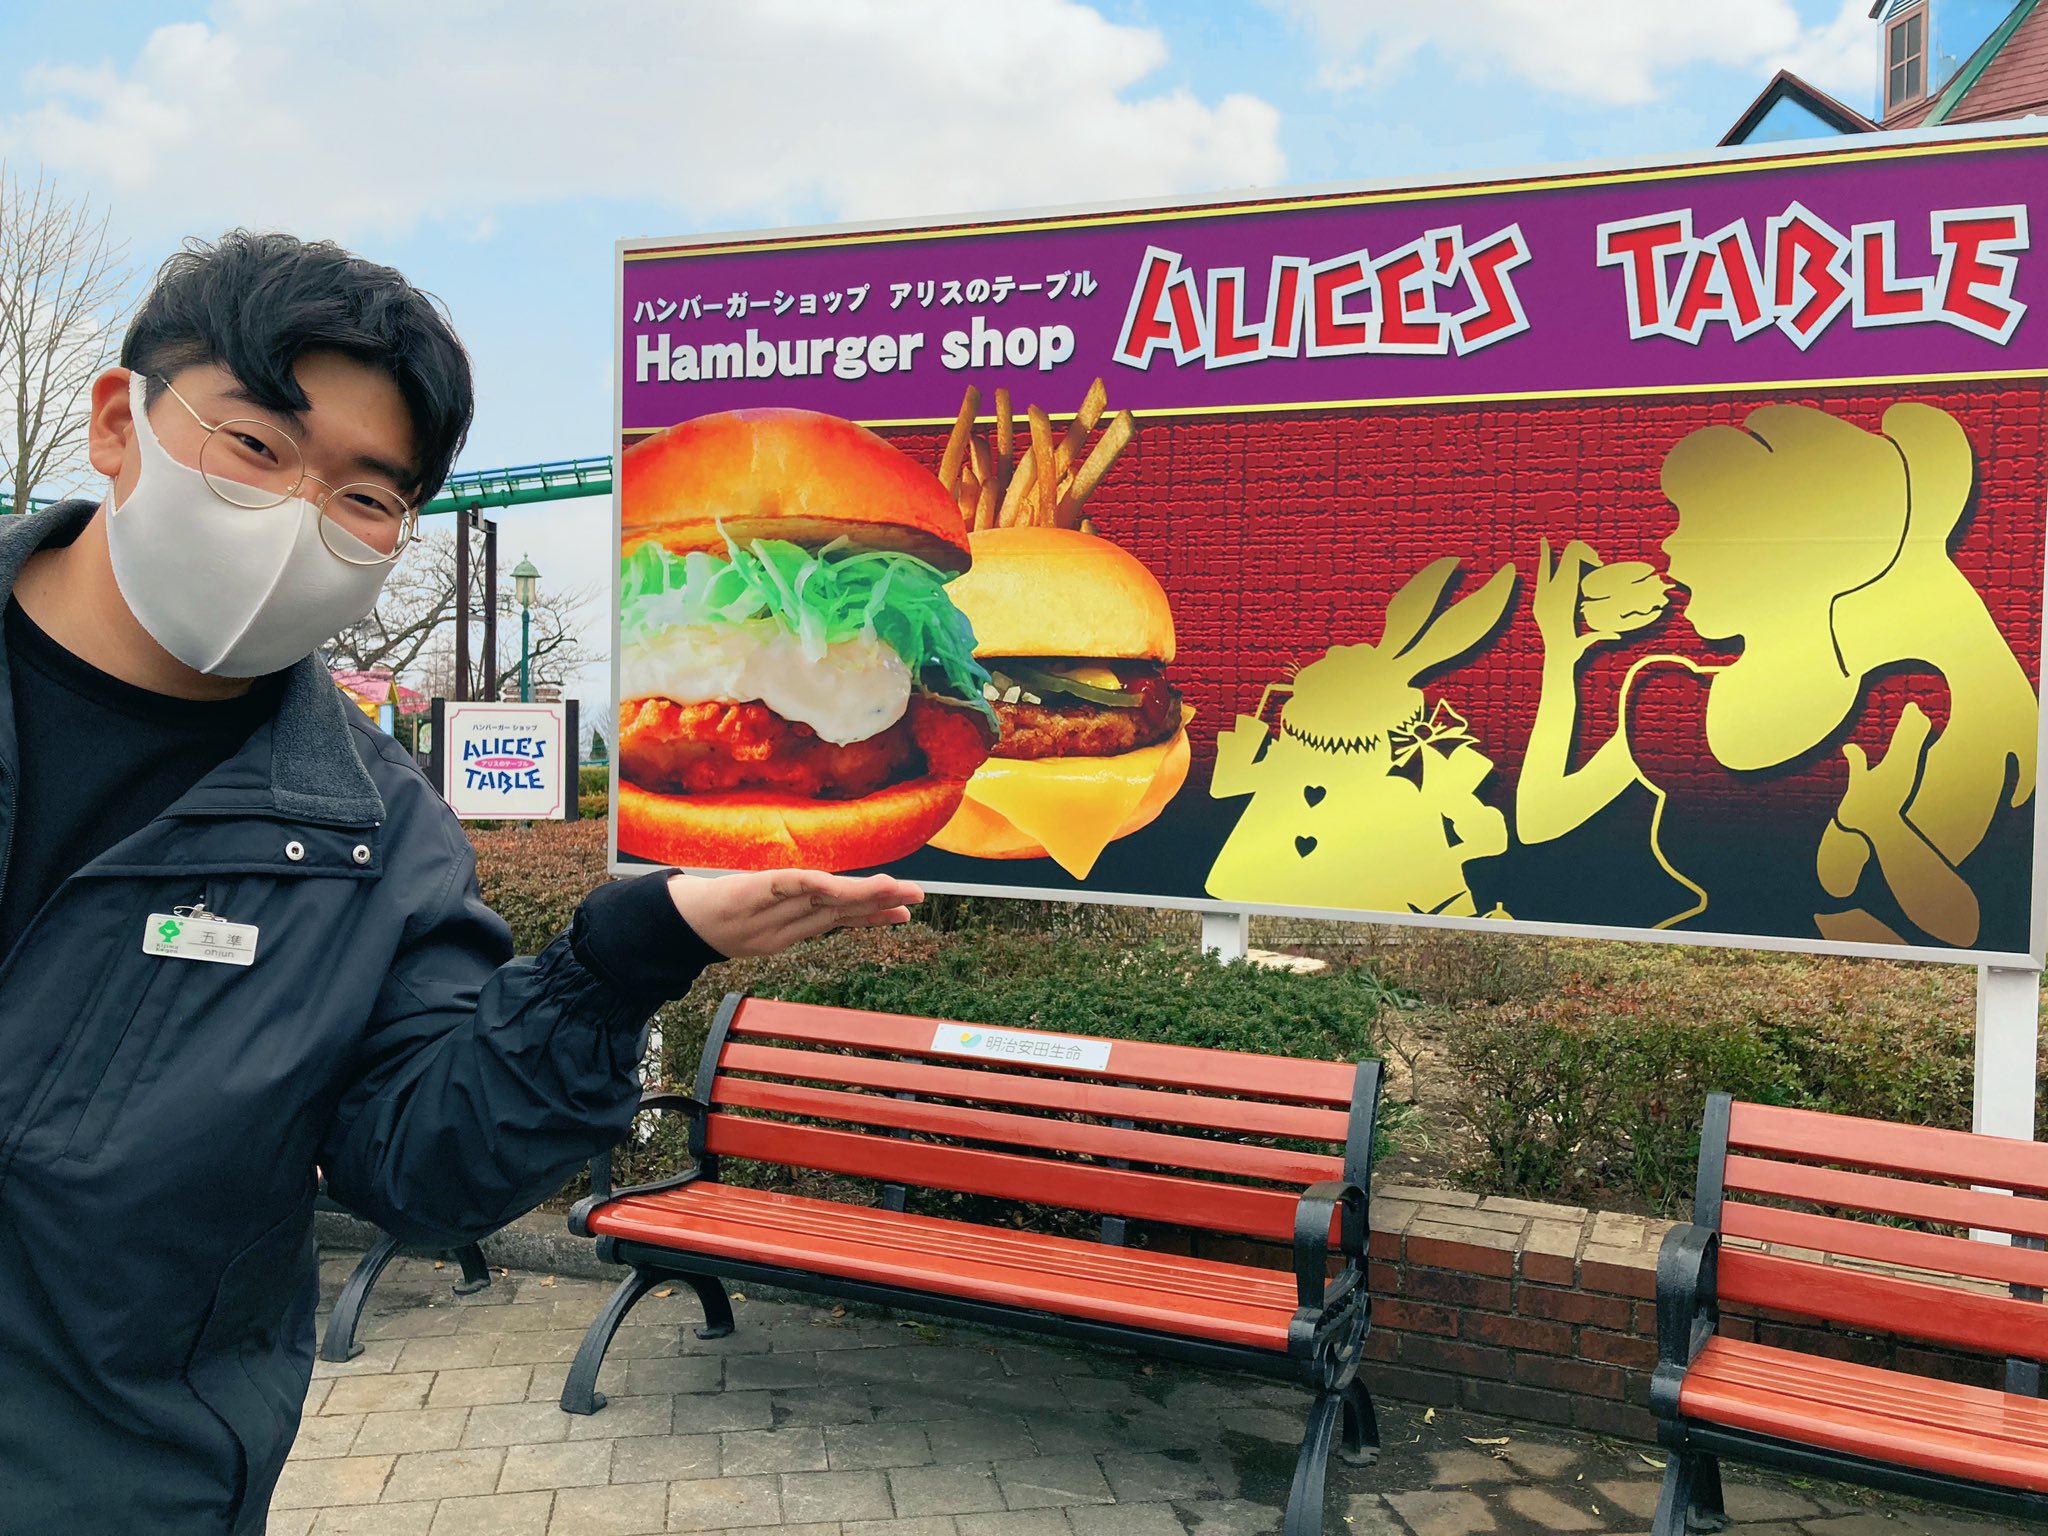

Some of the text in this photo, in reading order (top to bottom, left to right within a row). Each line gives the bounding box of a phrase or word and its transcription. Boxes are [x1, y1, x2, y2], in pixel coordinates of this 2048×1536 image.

[633, 269, 1099, 325] ハンバーガーショップ アリスのテーブル
[1112, 203, 2030, 370] ALICE'S TABLE
[635, 315, 1076, 382] Hamburger shop
[463, 737, 547, 760] ALICE'S
[465, 768, 545, 794] TABLE
[986, 1036, 1082, 1060] 明治安田生命
